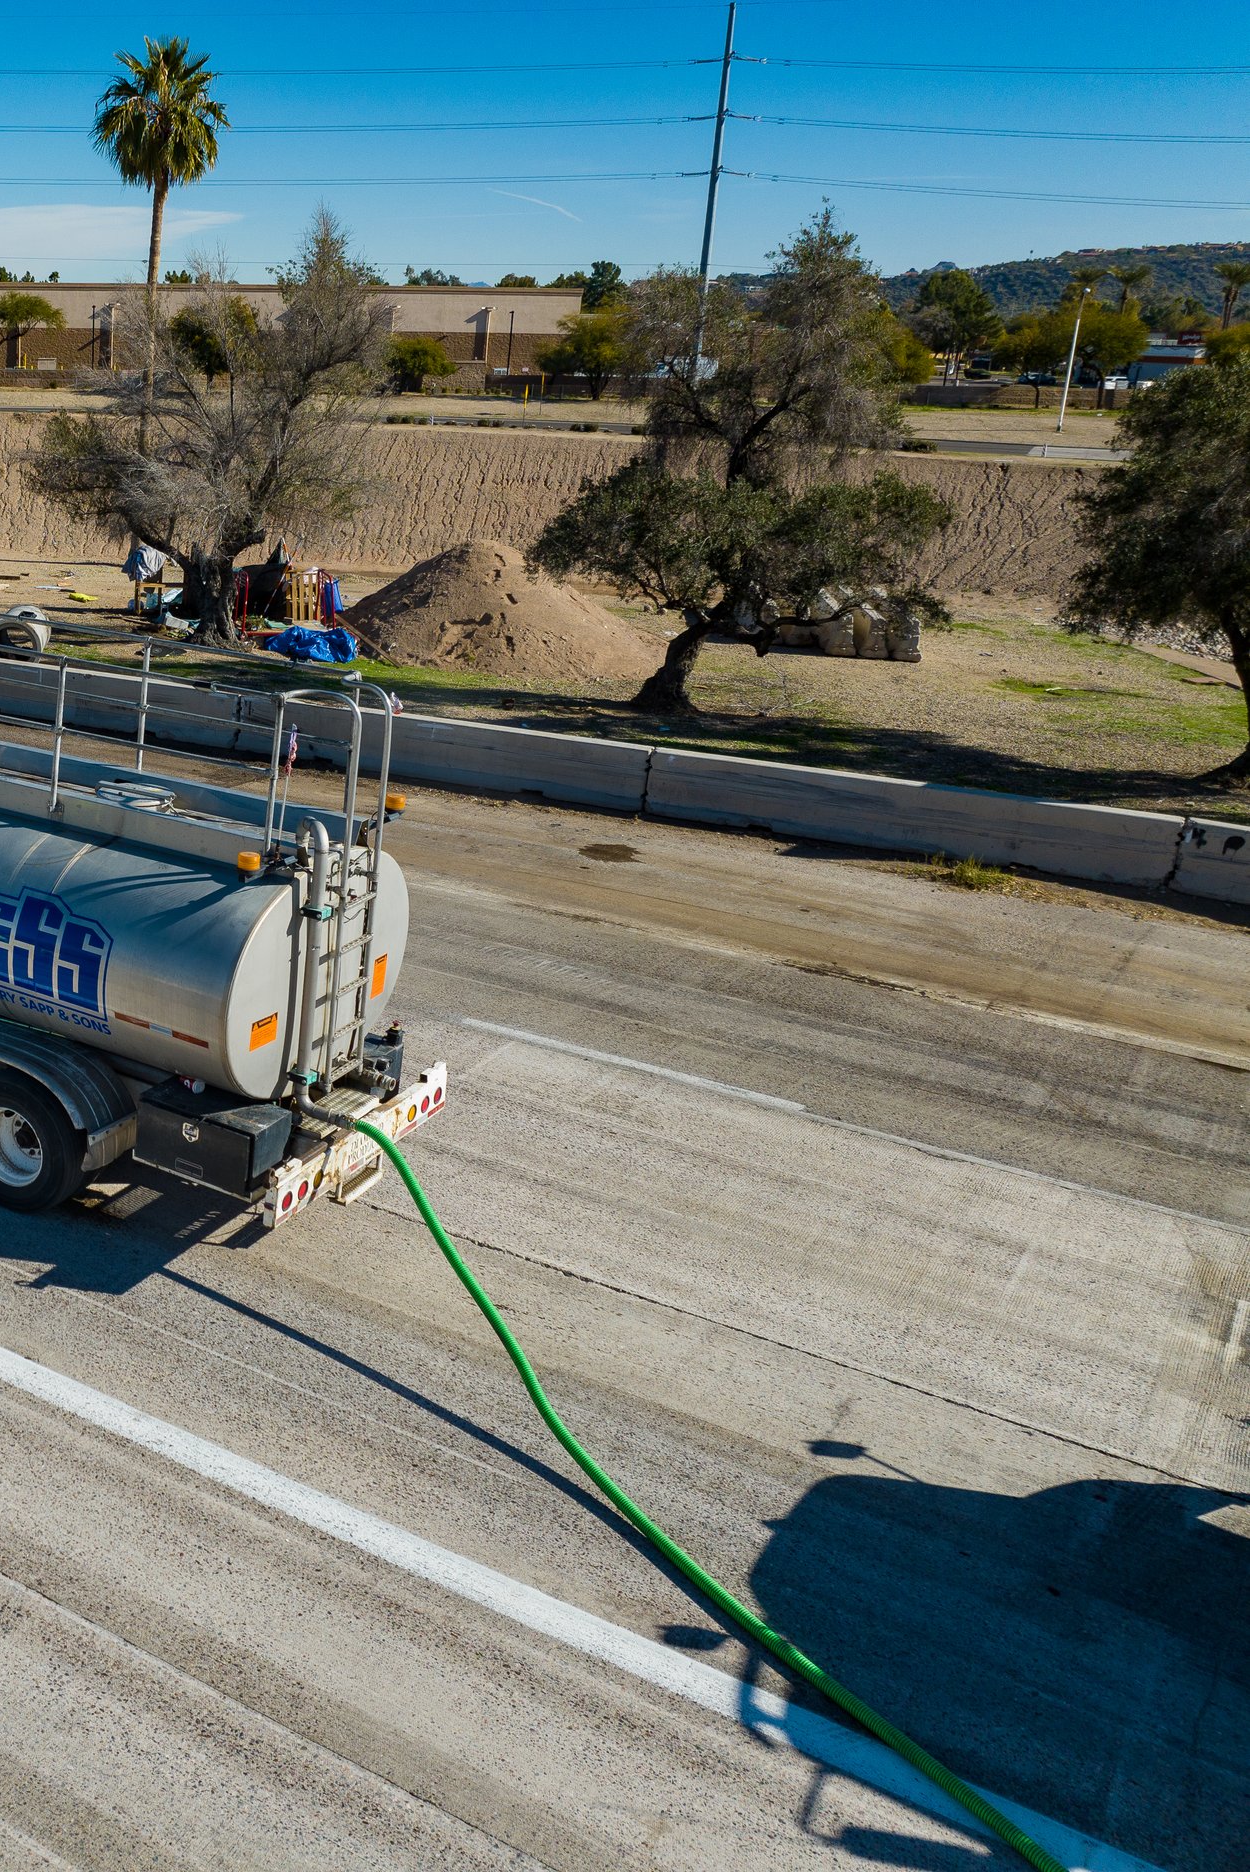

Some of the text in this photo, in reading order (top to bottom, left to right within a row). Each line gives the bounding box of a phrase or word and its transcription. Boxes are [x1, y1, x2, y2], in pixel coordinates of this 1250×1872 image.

[19, 997, 55, 1017] SAPP
[58, 1009, 69, 1022] &
[72, 1013, 112, 1036] SONS
